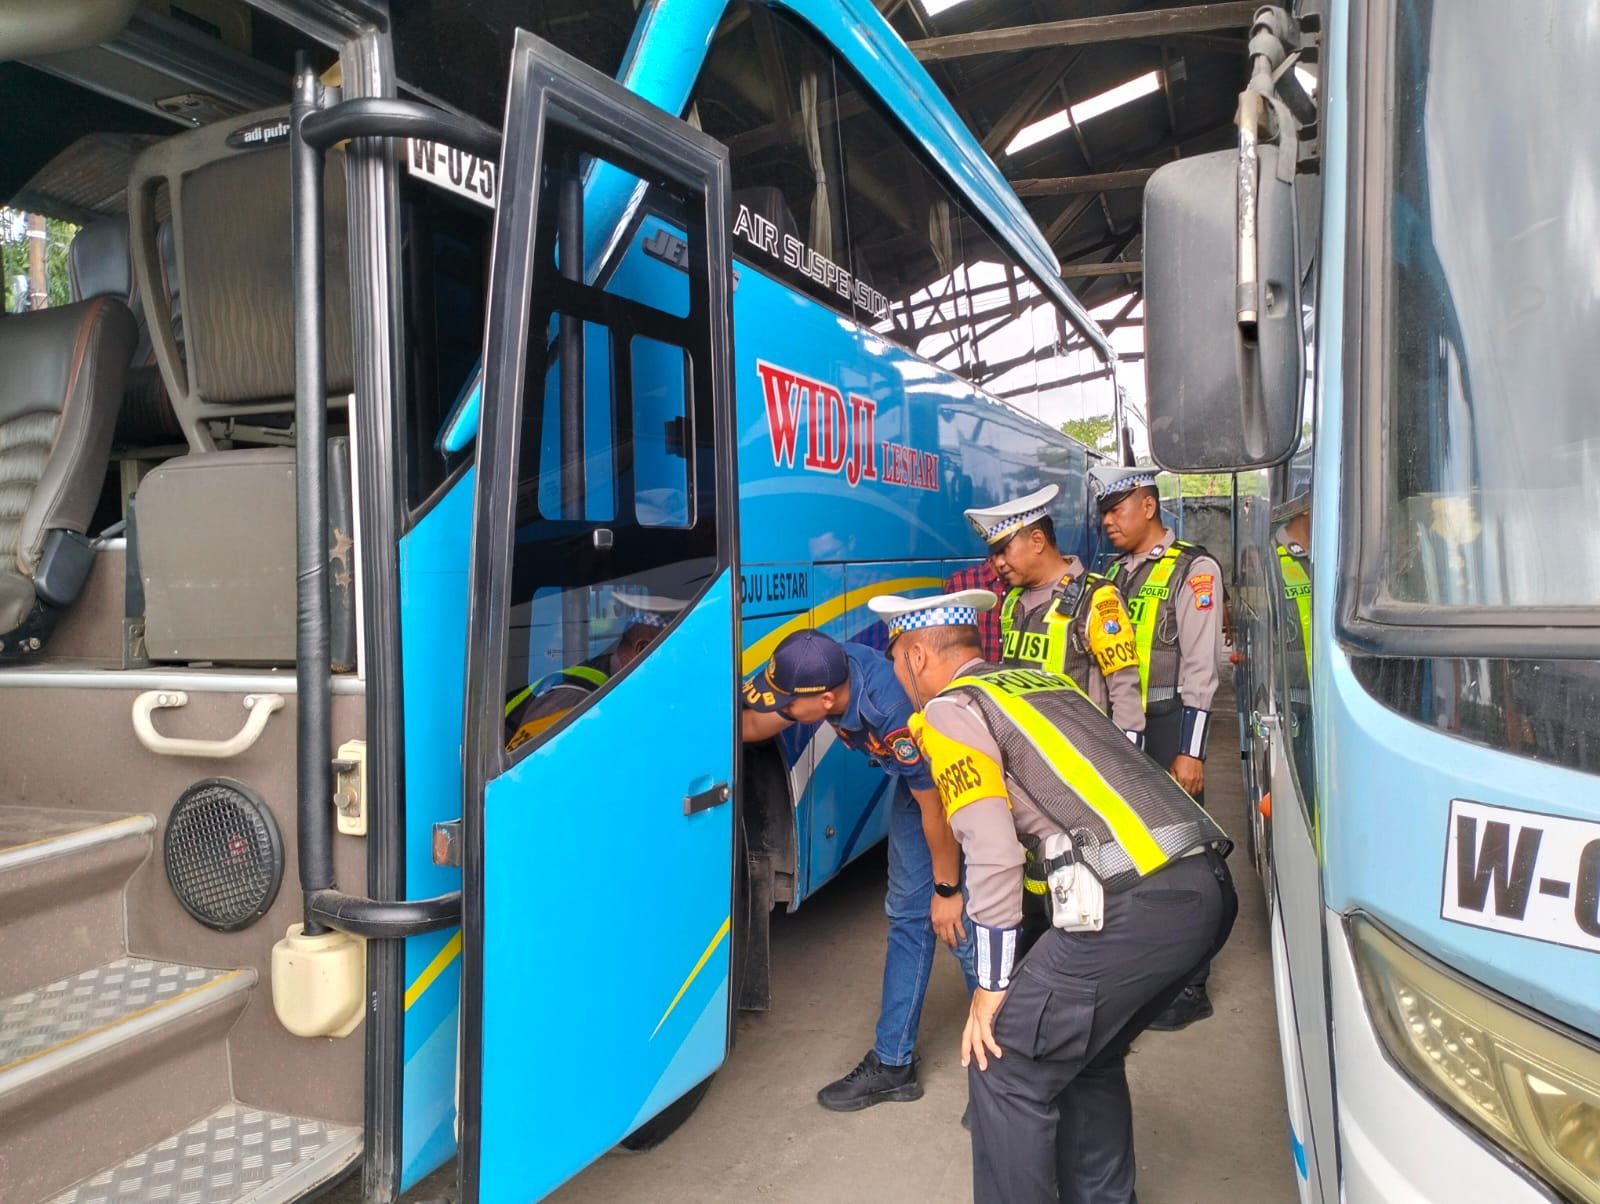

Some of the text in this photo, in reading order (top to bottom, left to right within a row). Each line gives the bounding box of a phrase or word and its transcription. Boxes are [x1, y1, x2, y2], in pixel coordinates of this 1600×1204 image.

[244, 127, 262, 142] adi
[733, 204, 779, 258] AIR
[757, 358, 940, 491] WIDJI LESTARI
[766, 571, 808, 601] LESTARI
[1140, 587, 1168, 598] POLRI
